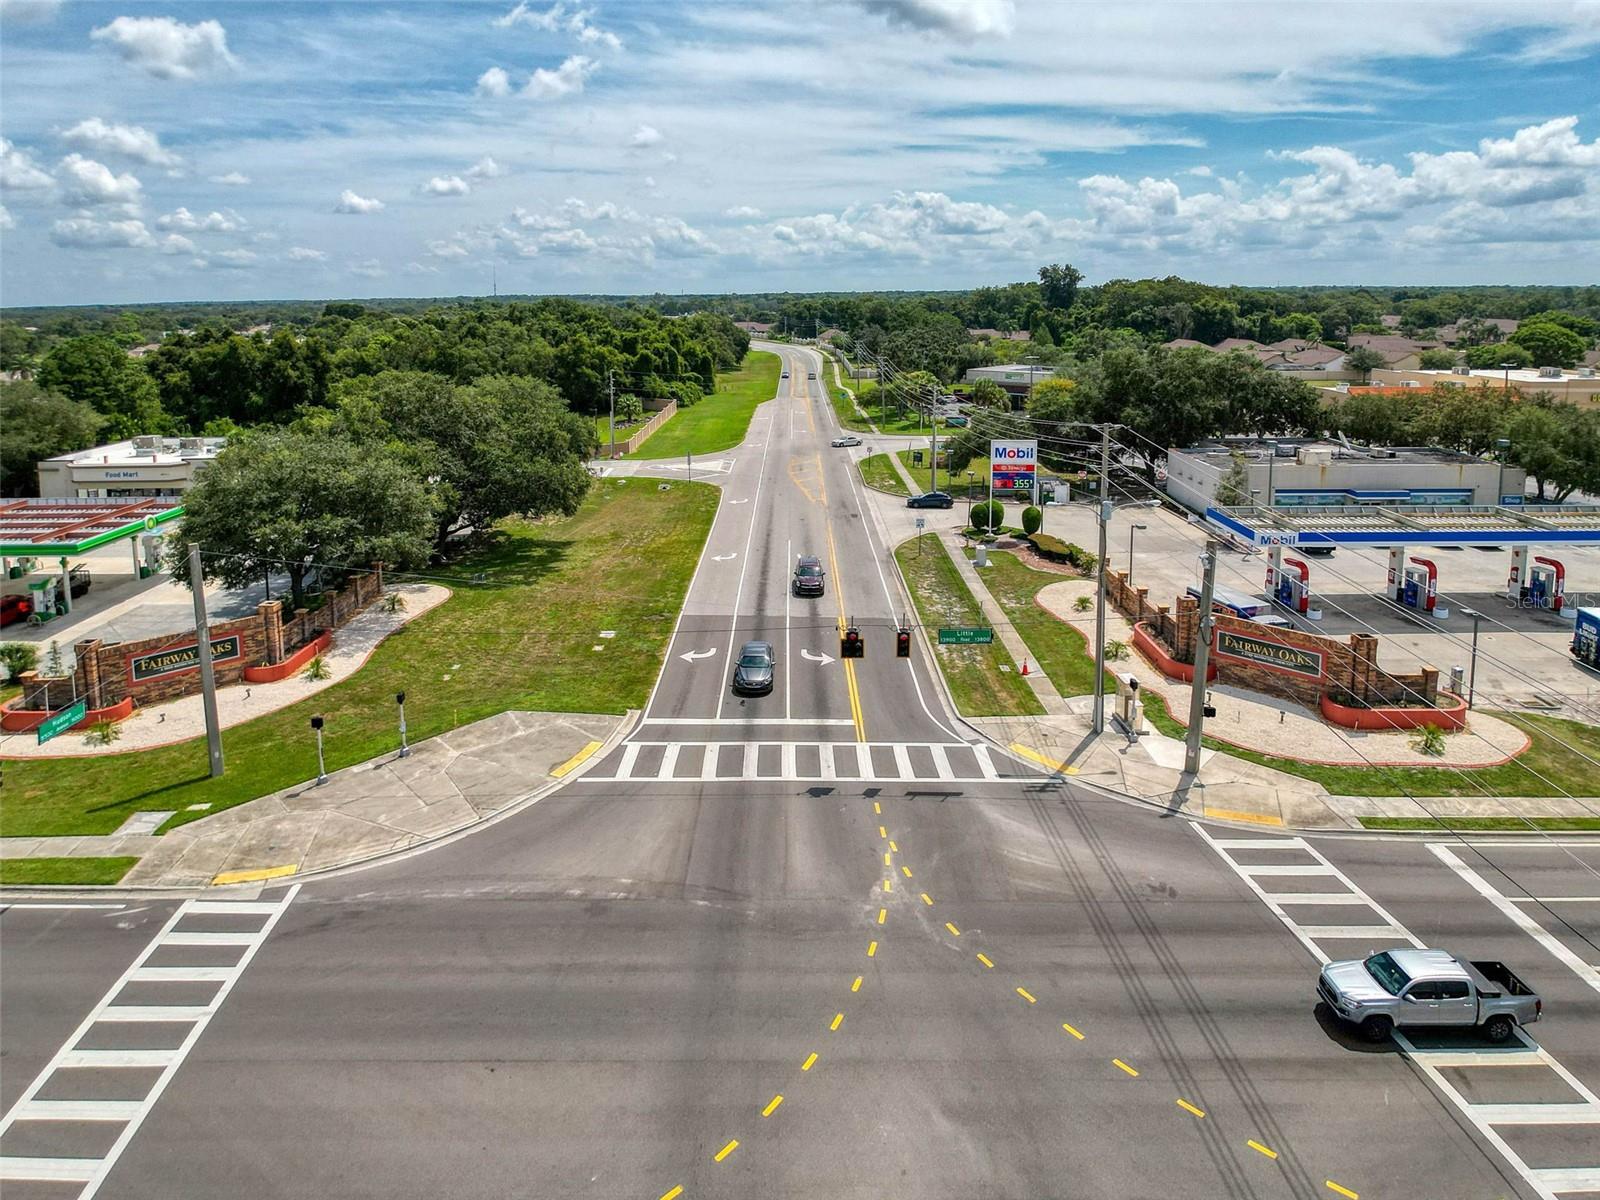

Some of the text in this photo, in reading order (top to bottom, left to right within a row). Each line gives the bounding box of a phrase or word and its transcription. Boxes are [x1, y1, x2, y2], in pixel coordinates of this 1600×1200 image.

[994, 447, 1034, 459] Mobil
[1260, 535, 1296, 545] Mobil
[140, 649, 197, 671] FAIRWAY
[210, 641, 233, 656] AKS
[1224, 636, 1277, 657] FAIRWAY
[1278, 649, 1314, 666] OAKS
